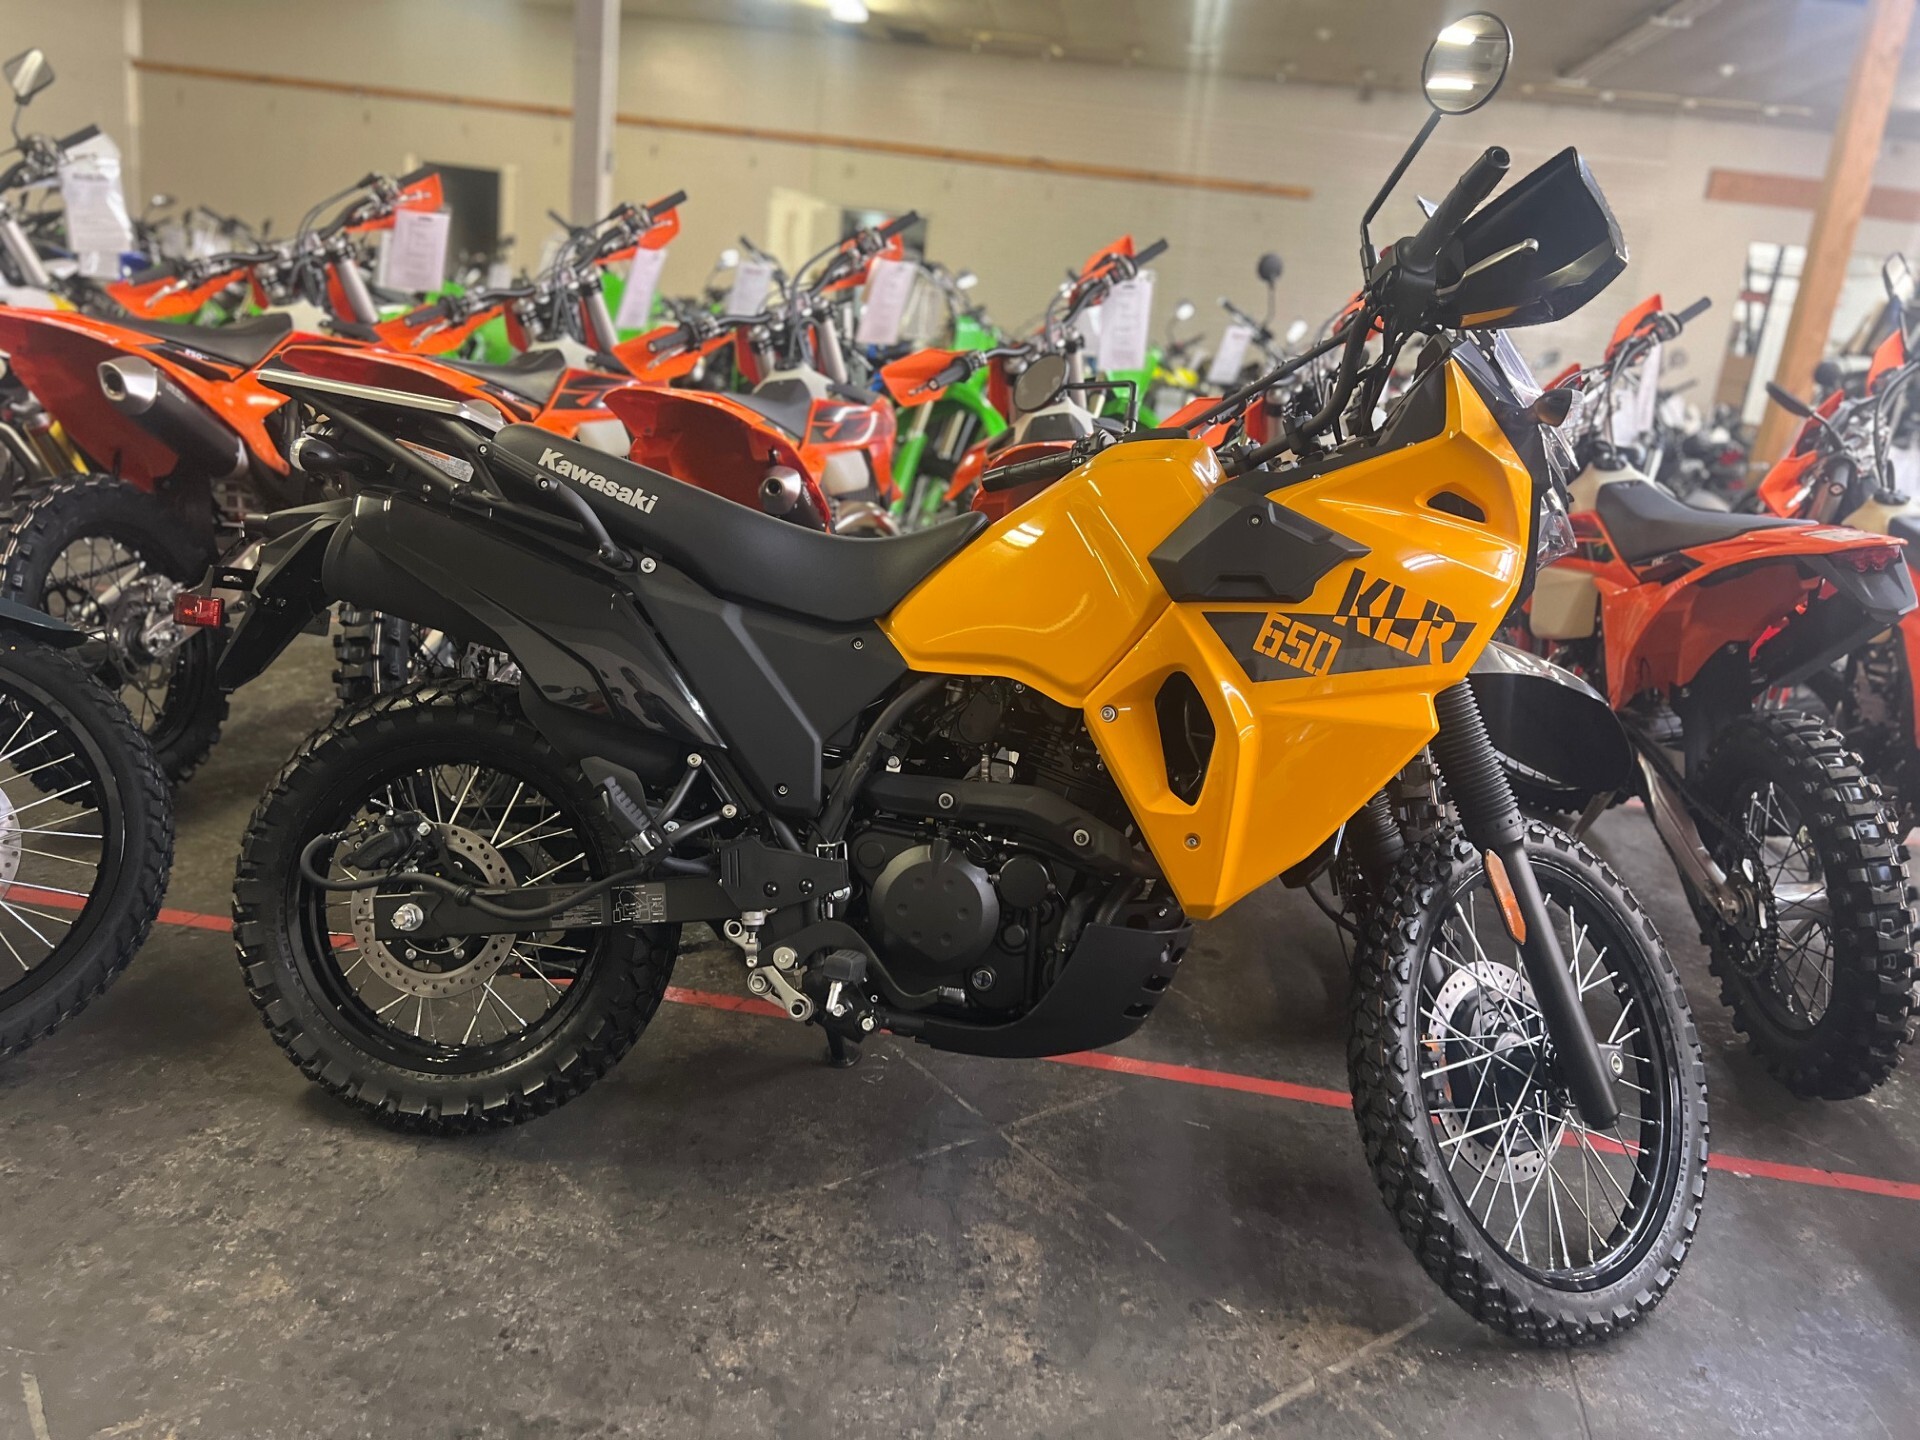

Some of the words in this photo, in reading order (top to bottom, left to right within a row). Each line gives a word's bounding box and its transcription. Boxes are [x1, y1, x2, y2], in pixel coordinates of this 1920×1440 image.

[538, 448, 658, 513] Kawasaki
[1253, 613, 1342, 676] 650
[1333, 568, 1456, 664] KLR
